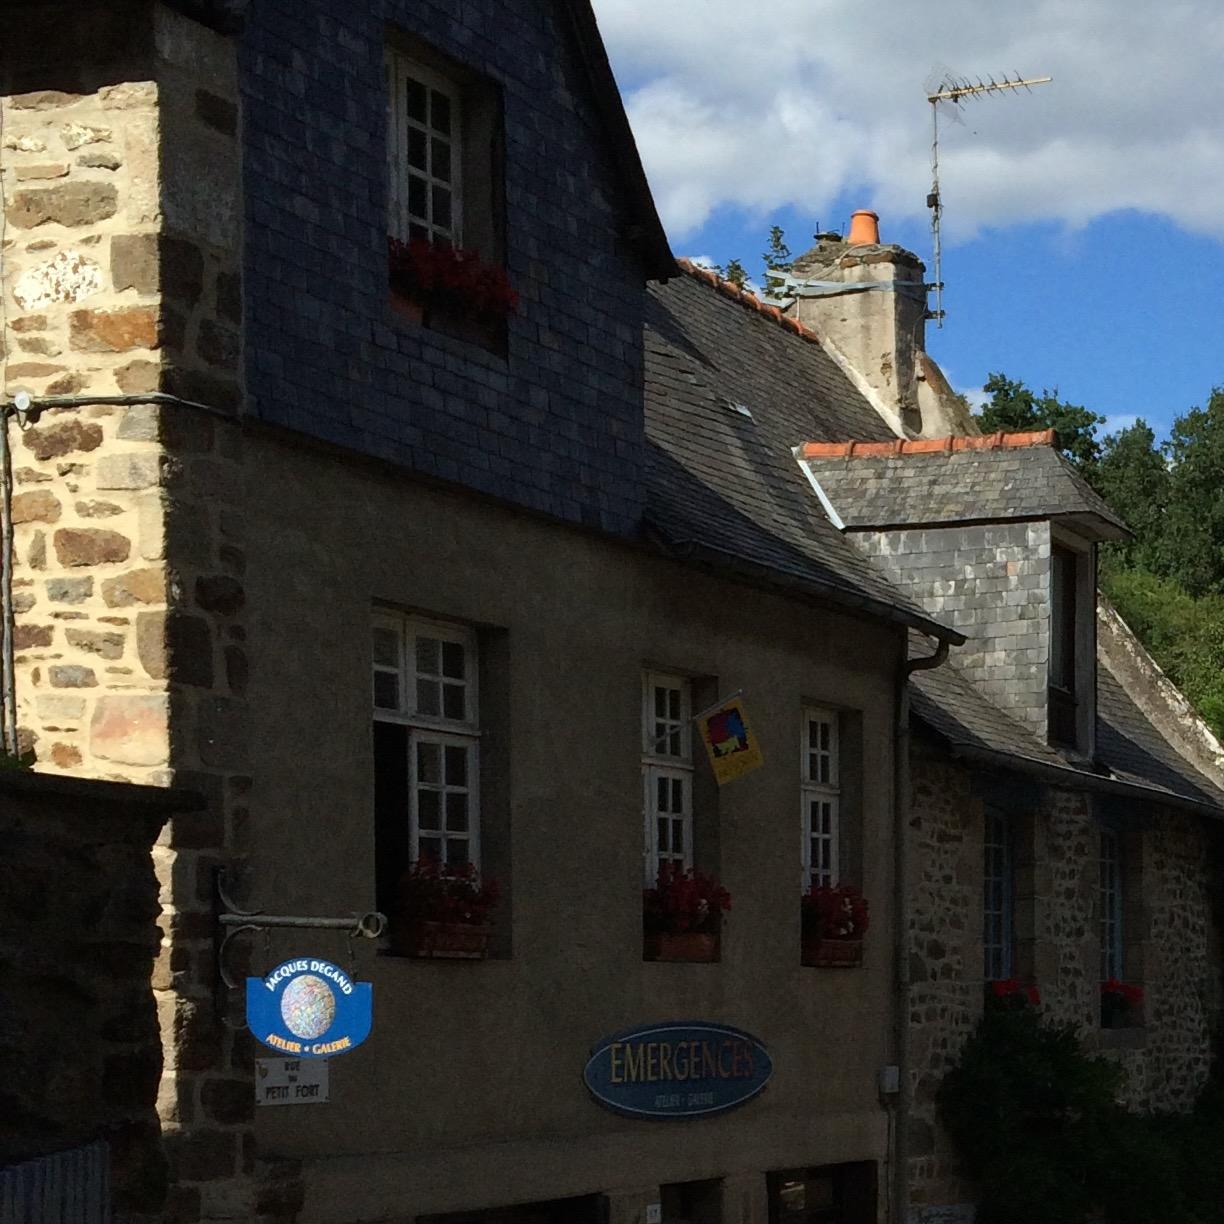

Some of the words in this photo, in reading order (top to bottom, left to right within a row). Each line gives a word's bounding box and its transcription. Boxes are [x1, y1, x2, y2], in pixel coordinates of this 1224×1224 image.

[265, 960, 308, 992] JACQUES
[310, 961, 353, 995] DEGAND
[266, 1033, 301, 1053] ATELIER
[312, 1036, 352, 1054] GALERIE
[610, 1041, 754, 1083] EMERGENCES
[266, 1086, 289, 1099] PETIT
[295, 1084, 320, 1097] FORT
